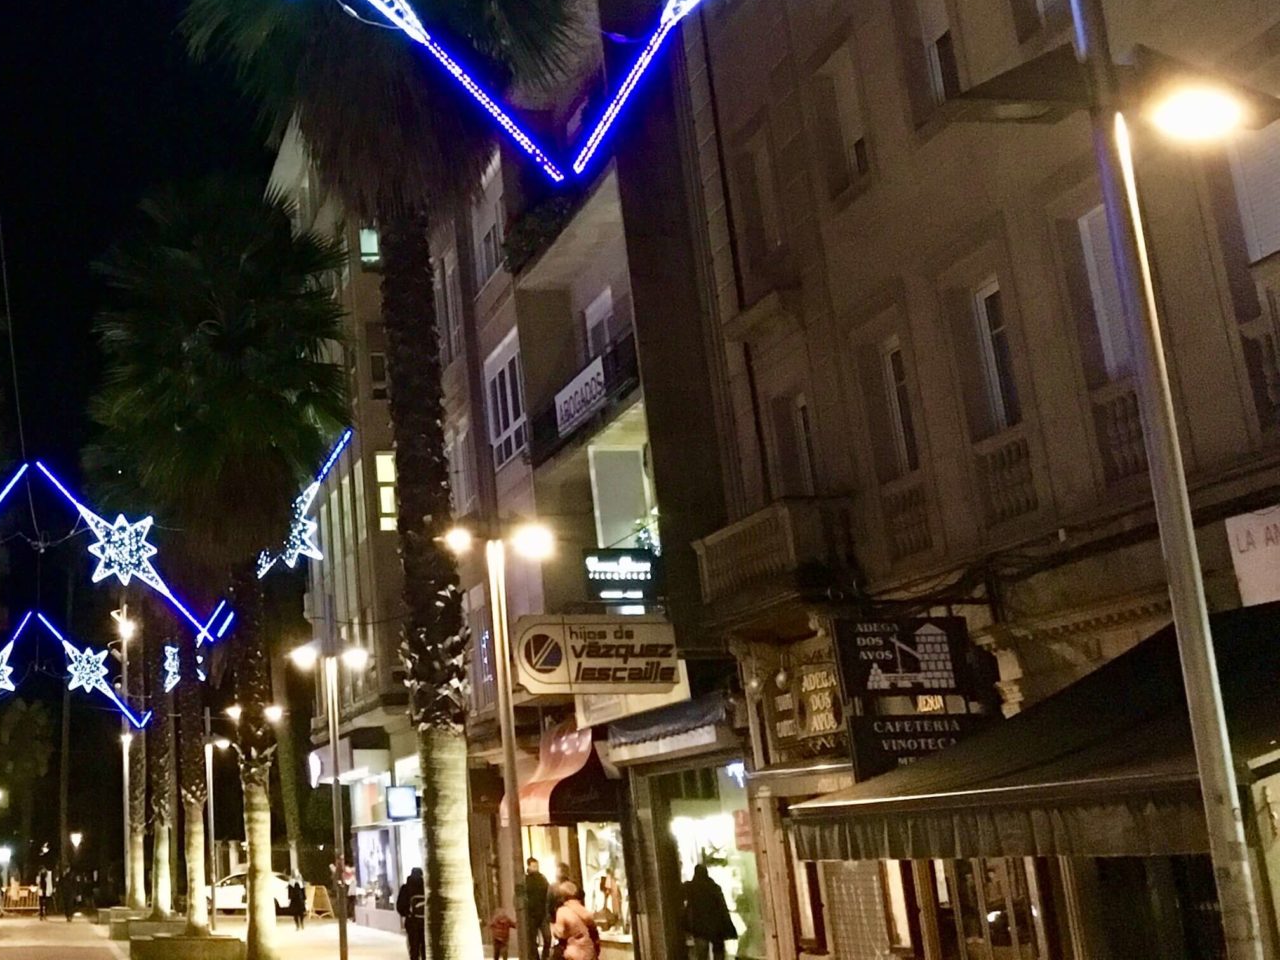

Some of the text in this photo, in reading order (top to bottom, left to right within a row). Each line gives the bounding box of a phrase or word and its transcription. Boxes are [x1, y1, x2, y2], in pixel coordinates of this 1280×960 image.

[560, 372, 604, 424] ABOGADOS
[569, 627, 634, 642] hijos de
[854, 623, 900, 633] ADEGA
[856, 636, 884, 647] DOS
[575, 661, 675, 683] lescaille
[809, 691, 832, 712] DOS
[873, 719, 961, 734] CAFETERIA
